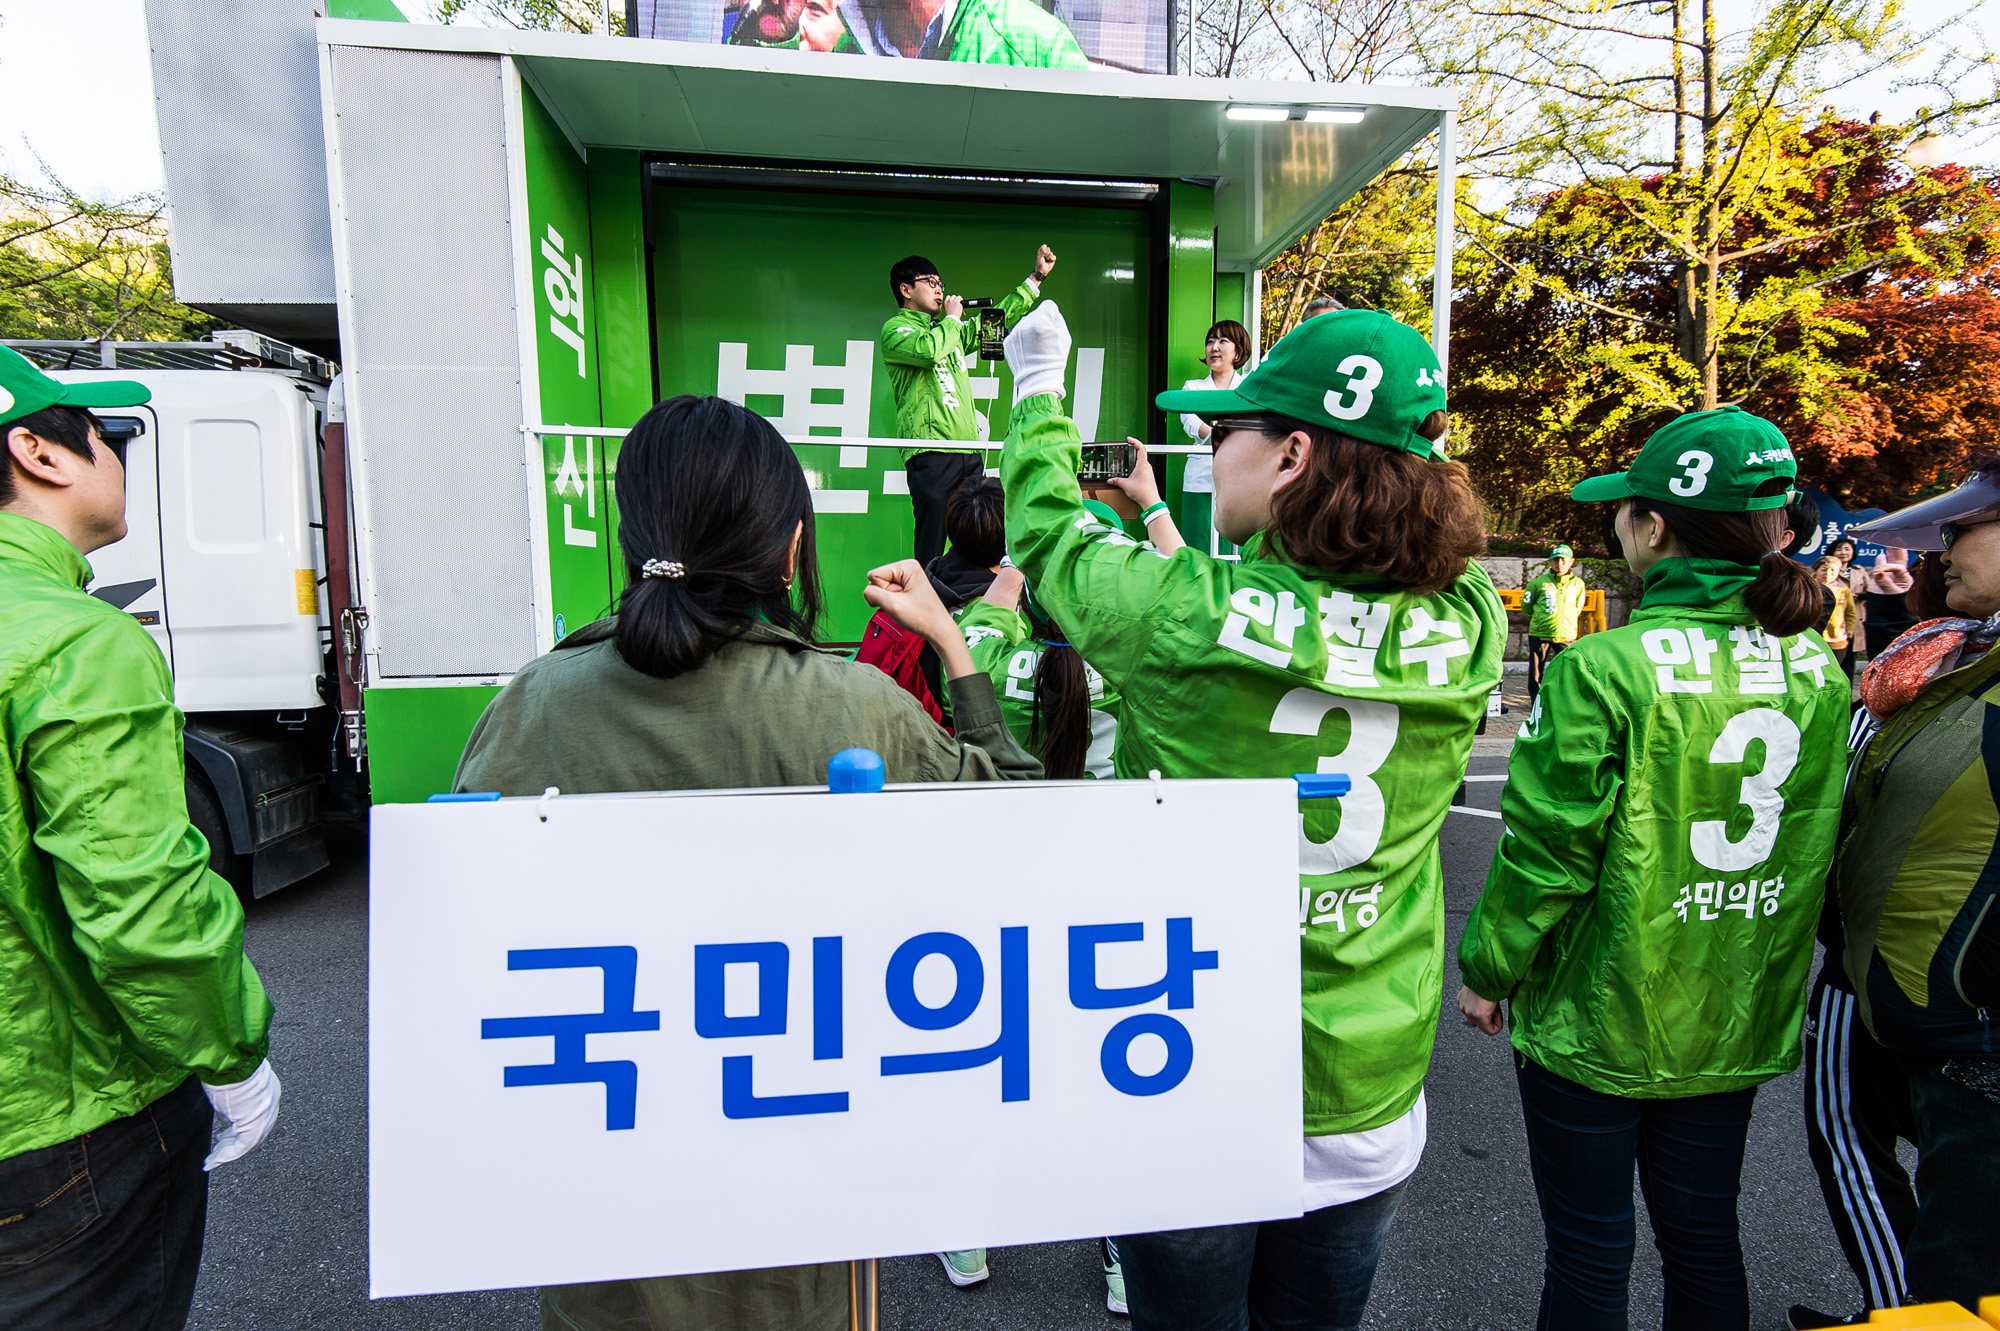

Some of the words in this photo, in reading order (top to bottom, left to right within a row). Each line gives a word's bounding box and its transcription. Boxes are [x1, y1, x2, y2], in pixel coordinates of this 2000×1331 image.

[1323, 354, 1384, 421] 3
[1669, 450, 1714, 497] 3
[1761, 448, 1795, 463] 국민의
[1523, 590, 1532, 603] 3
[1217, 587, 1471, 688] 안철수
[1641, 626, 1830, 695] 안철수
[1269, 687, 1399, 876] 3
[1690, 707, 1801, 872] 3
[1672, 876, 1785, 924] 국민의당
[481, 917, 1219, 1132] 국민의당
